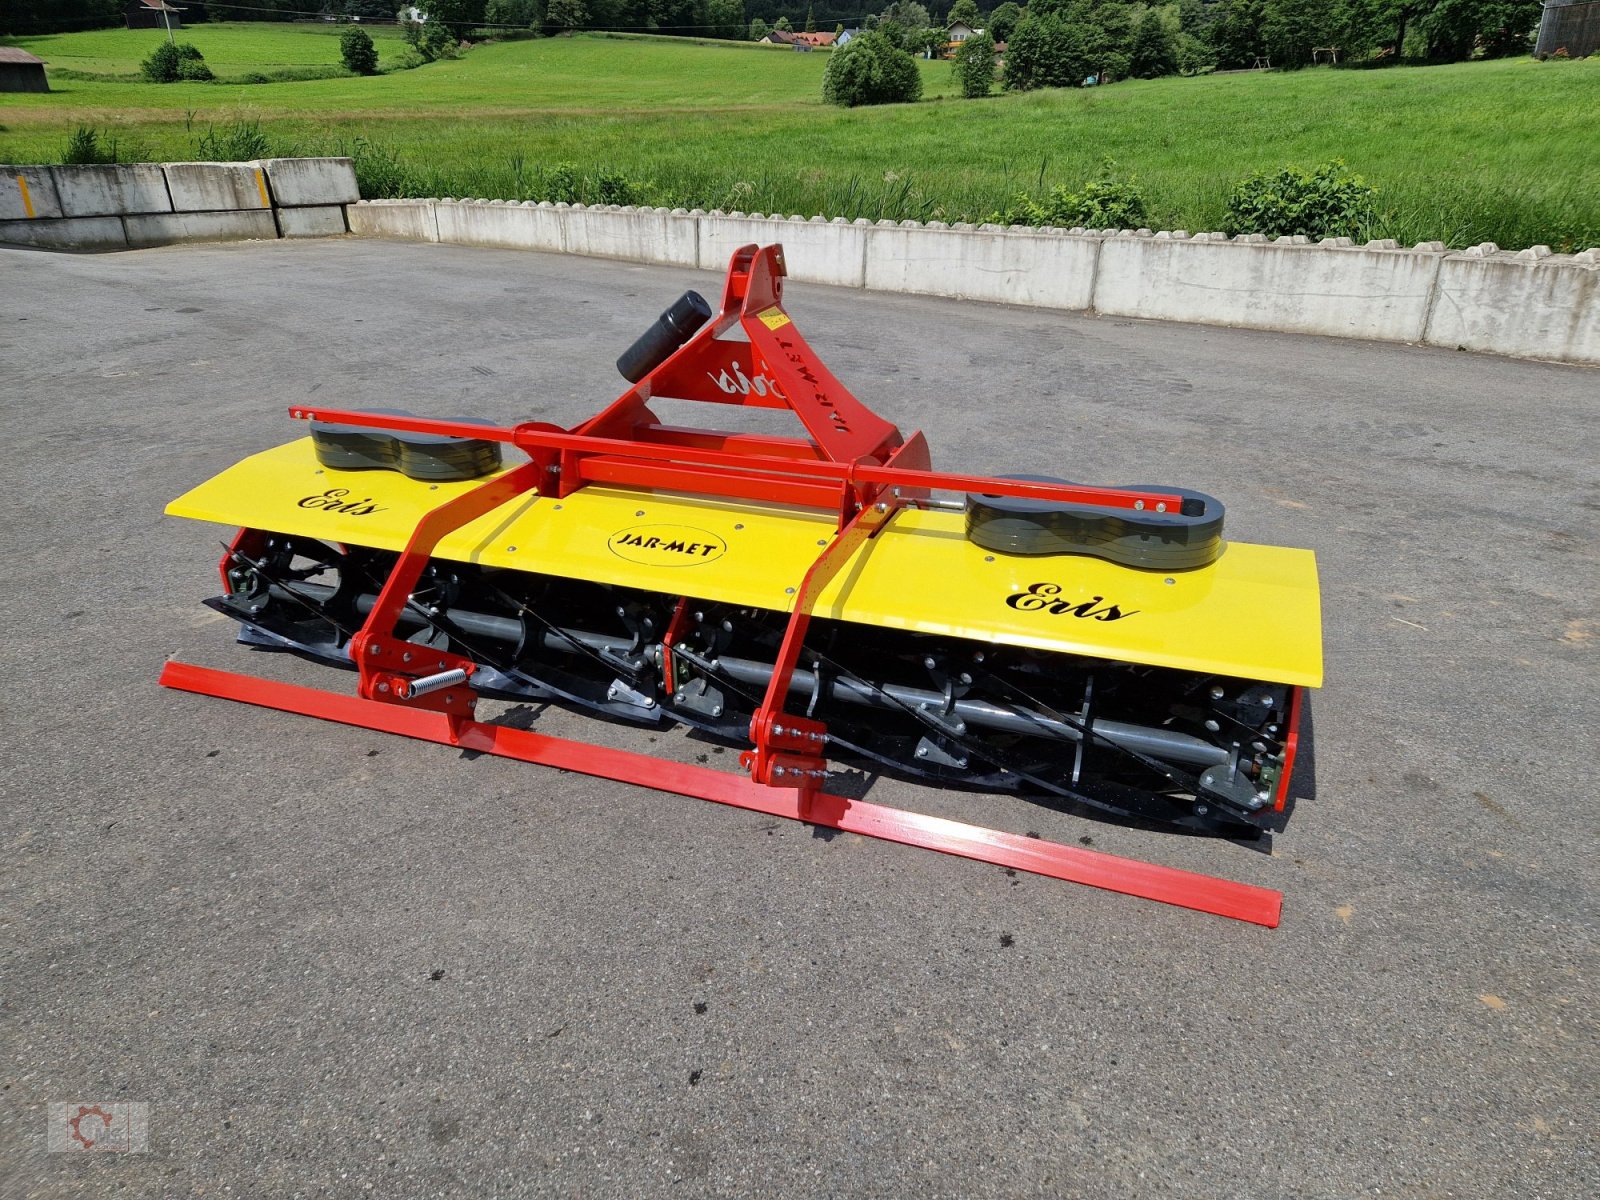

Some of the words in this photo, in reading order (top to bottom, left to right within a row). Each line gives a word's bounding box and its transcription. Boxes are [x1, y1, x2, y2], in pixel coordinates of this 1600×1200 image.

[297, 489, 389, 515] Eris
[617, 533, 717, 556] JAR-MET
[1006, 582, 1141, 621] Eris
